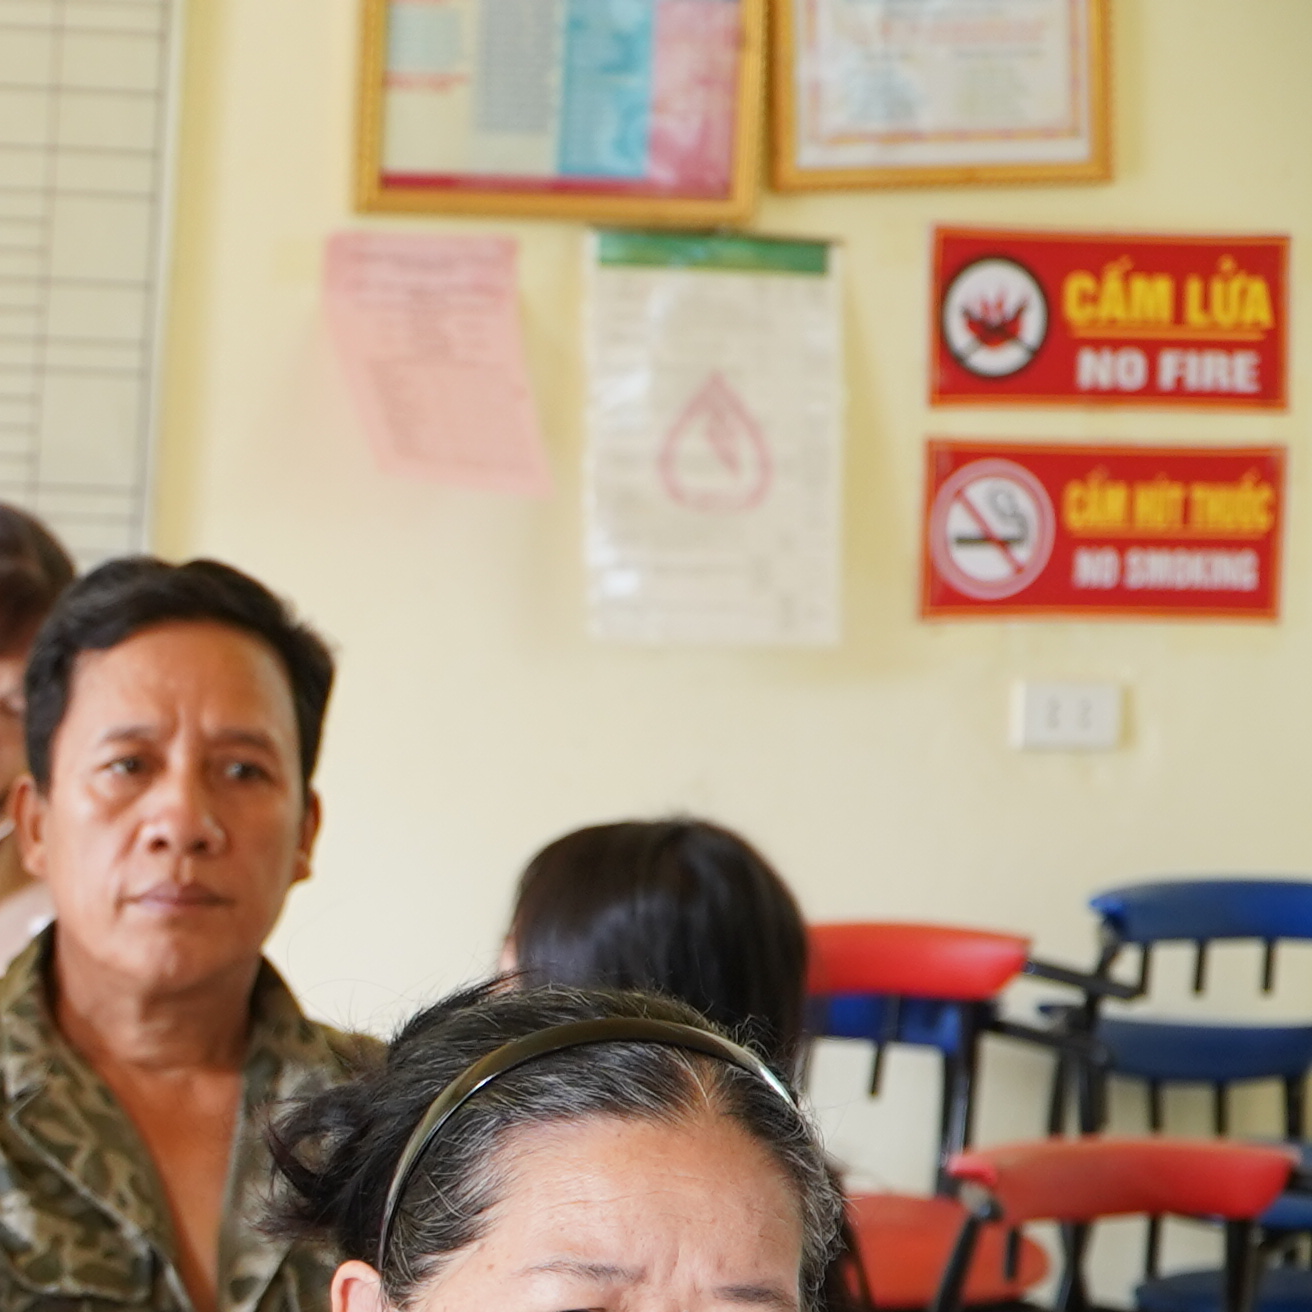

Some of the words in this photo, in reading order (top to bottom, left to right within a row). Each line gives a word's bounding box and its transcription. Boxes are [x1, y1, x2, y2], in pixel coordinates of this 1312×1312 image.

[1063, 255, 1174, 328] CẤM
[1184, 254, 1276, 330] LỬA
[1076, 347, 1147, 392] NO
[1158, 348, 1261, 394] FIRE
[1064, 464, 1130, 531] CẤM
[1189, 467, 1274, 533] THUỐC
[1073, 547, 1120, 587] NO
[1123, 548, 1259, 592] SMOKING
